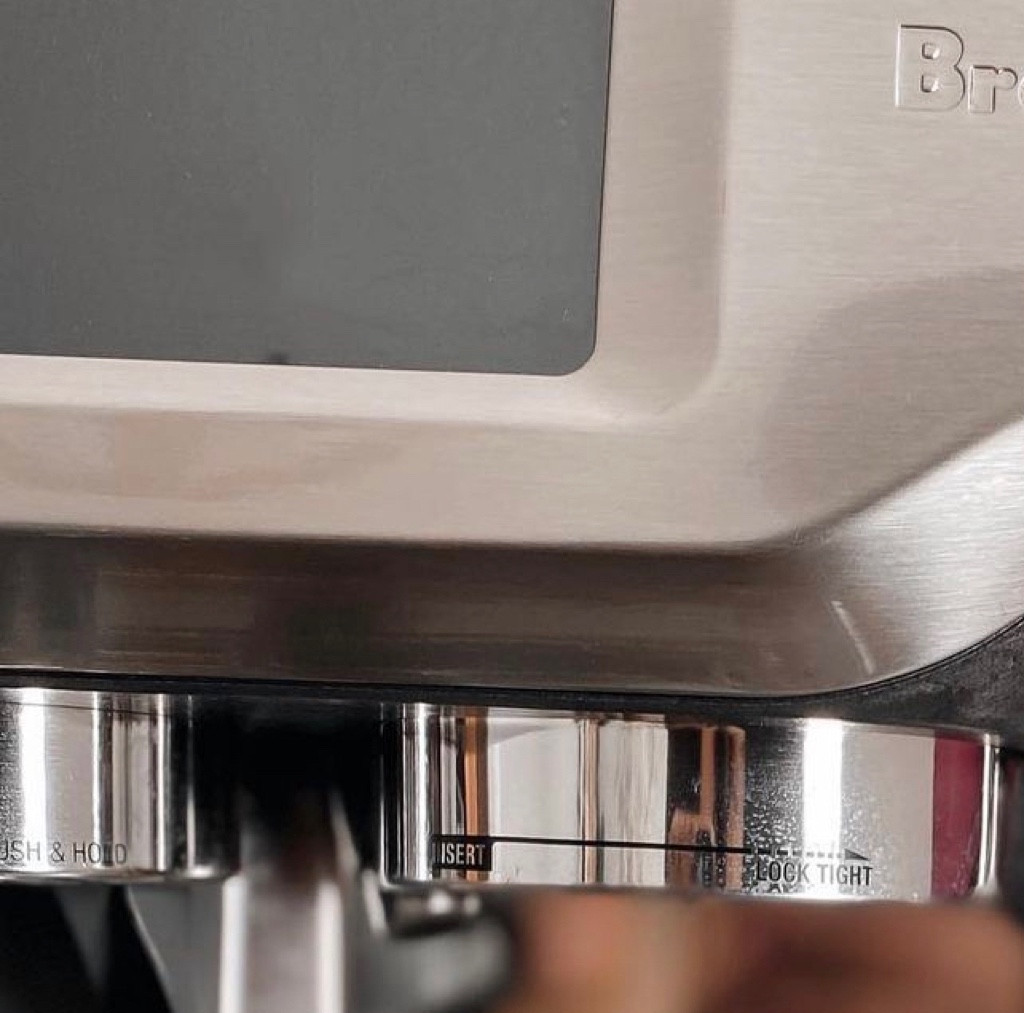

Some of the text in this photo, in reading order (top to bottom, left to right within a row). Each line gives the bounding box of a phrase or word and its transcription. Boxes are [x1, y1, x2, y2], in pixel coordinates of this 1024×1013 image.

[50, 841, 65, 862] &
[72, 841, 127, 866] HOLD
[756, 860, 872, 886] LOCK TIGHT
